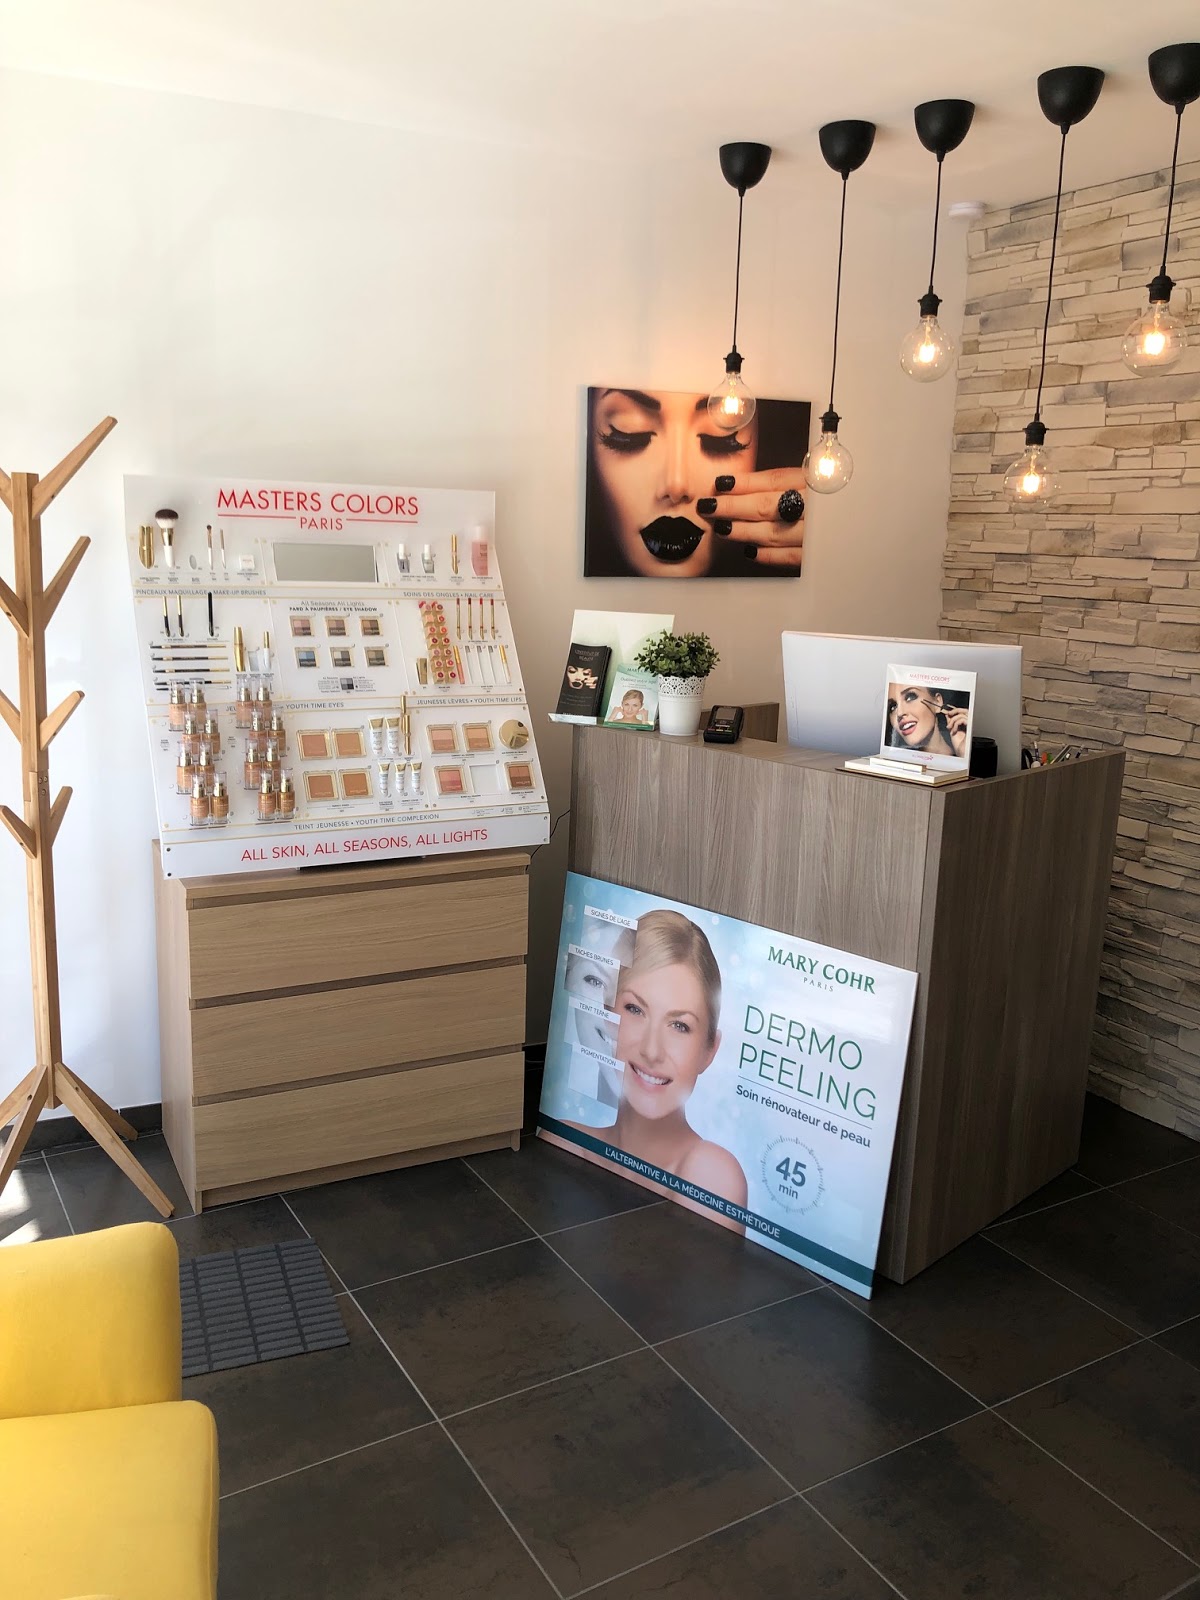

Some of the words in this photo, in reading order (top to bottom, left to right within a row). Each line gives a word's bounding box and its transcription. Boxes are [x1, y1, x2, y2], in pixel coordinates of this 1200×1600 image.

[218, 488, 321, 512] MASTERS
[330, 494, 418, 516] COLORS
[300, 516, 343, 530] PARIS
[398, 814, 440, 823] COMPLEXION
[241, 849, 268, 862] ALL
[272, 846, 309, 858] SKIN,
[314, 842, 339, 854] ALL
[344, 836, 412, 852] SEASONS,
[416, 833, 439, 846] ALL
[443, 829, 488, 843] LIGHTS
[591, 909, 609, 919] SIGNES
[593, 953, 614, 966] BRUNES
[768, 946, 820, 975] MARY
[822, 964, 876, 994] COHR
[804, 977, 834, 992] PARIS
[579, 1002, 593, 1014] TEINT
[593, 1007, 609, 1019] TERNE
[744, 1004, 862, 1070] DERMO
[580, 1048, 616, 1067] PIGMENTATION
[739, 1042, 876, 1120] PEELING
[736, 1084, 759, 1103] Soin
[760, 1094, 820, 1127] rénovateur
[822, 1120, 838, 1134] de
[840, 1129, 871, 1148] peau
[776, 1156, 807, 1187] 45
[605, 1146, 660, 1181] L'ALTERNATIVE
[662, 1172, 668, 1184] À
[670, 1177, 680, 1190] LA
[682, 1183, 725, 1210] MÉDECINE
[726, 1206, 781, 1238] ESTHÉTIQUE
[778, 1183, 798, 1200] min
